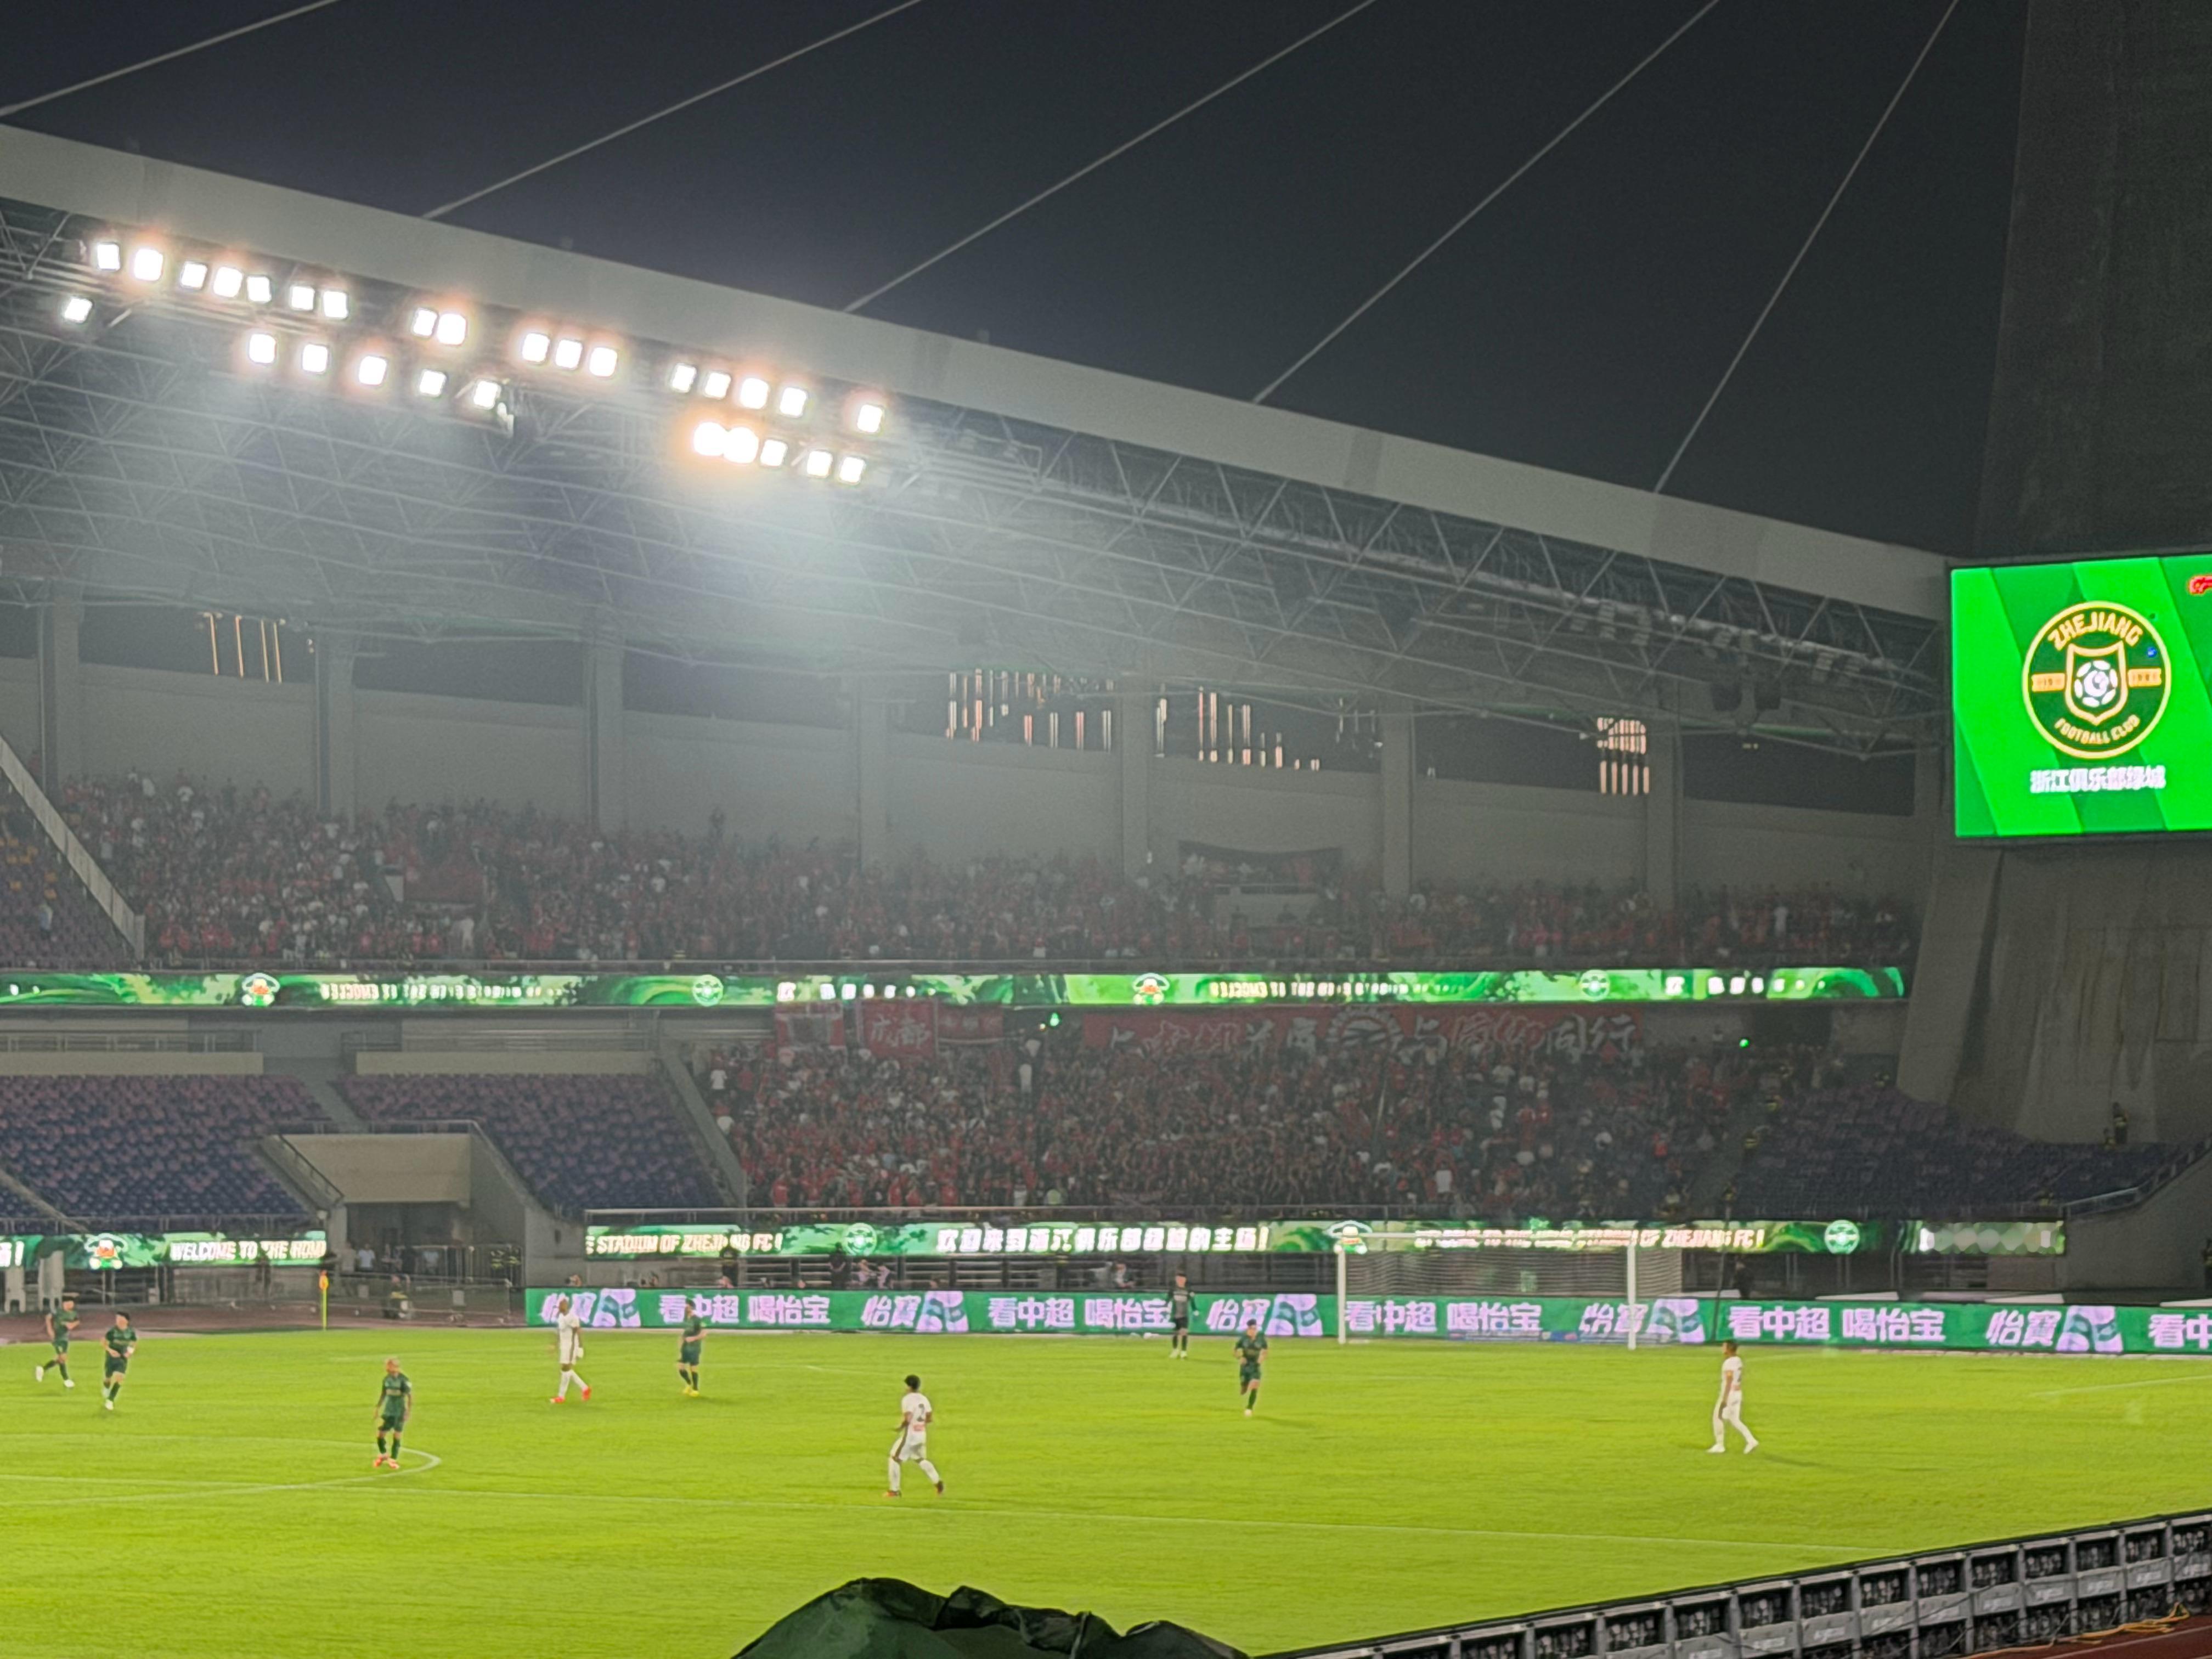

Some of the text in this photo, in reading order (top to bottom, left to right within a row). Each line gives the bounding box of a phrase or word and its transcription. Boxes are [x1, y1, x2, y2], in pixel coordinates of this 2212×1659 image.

[2048, 611, 2143, 650] ZHEJIANG
[2055, 718, 2111, 744] FOOTBALL
[171, 1241, 236, 1261] WELCOME
[238, 1241, 258, 1260] TO
[659, 1235, 681, 1252] OF
[748, 1295, 830, 1324] 喝怡宝
[989, 1297, 1176, 1329] 看中超 喝怡宝
[1346, 1300, 1542, 1332] 看中超 喝怡宝
[1729, 1306, 1945, 1341] 看中超 喝怡宝
